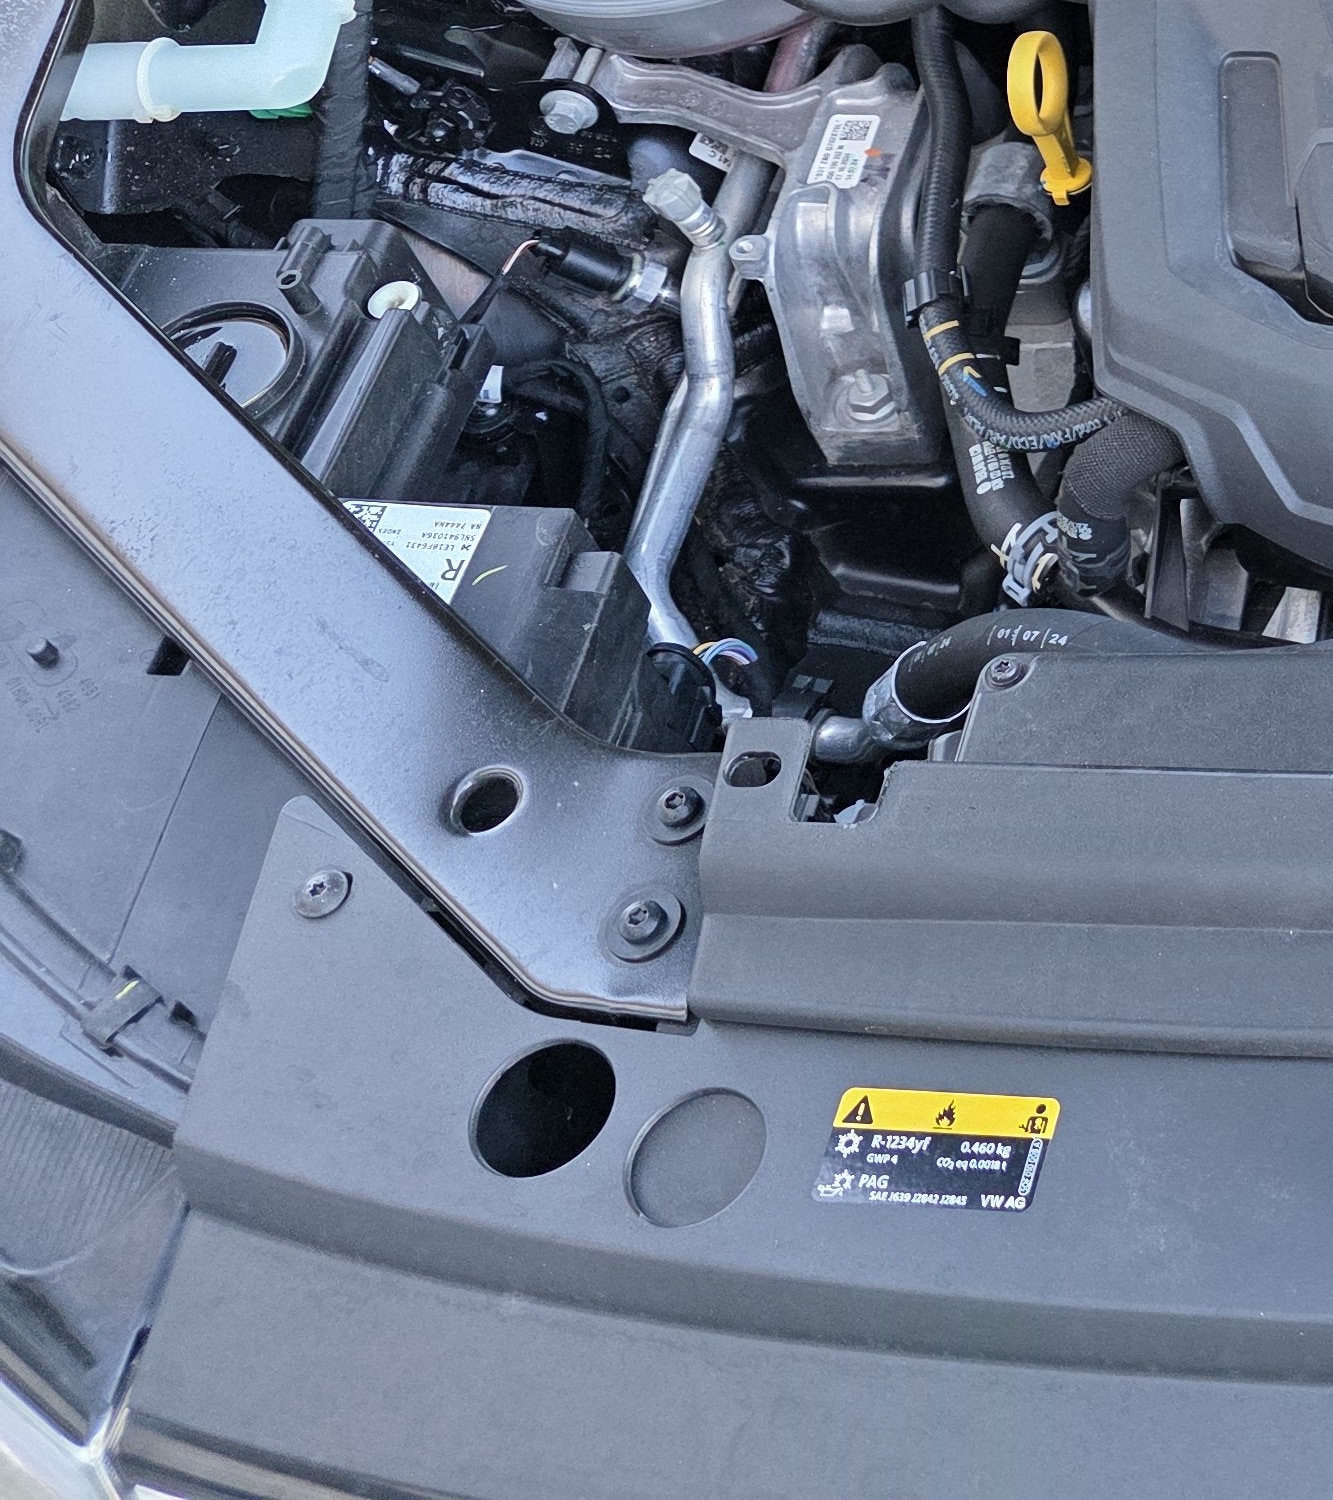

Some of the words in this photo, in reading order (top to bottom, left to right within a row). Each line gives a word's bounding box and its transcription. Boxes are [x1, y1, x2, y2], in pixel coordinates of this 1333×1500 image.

[440, 558, 466, 582] R
[870, 1134, 931, 1153] R-1234yf
[960, 1141, 996, 1155] 0.460
[995, 1142, 1012, 1159] kg
[866, 1152, 891, 1164] GWP
[890, 1154, 899, 1165] 4
[858, 1174, 890, 1189] PAG
[981, 1194, 1005, 1208] VW
[1003, 1195, 1026, 1210] AG
